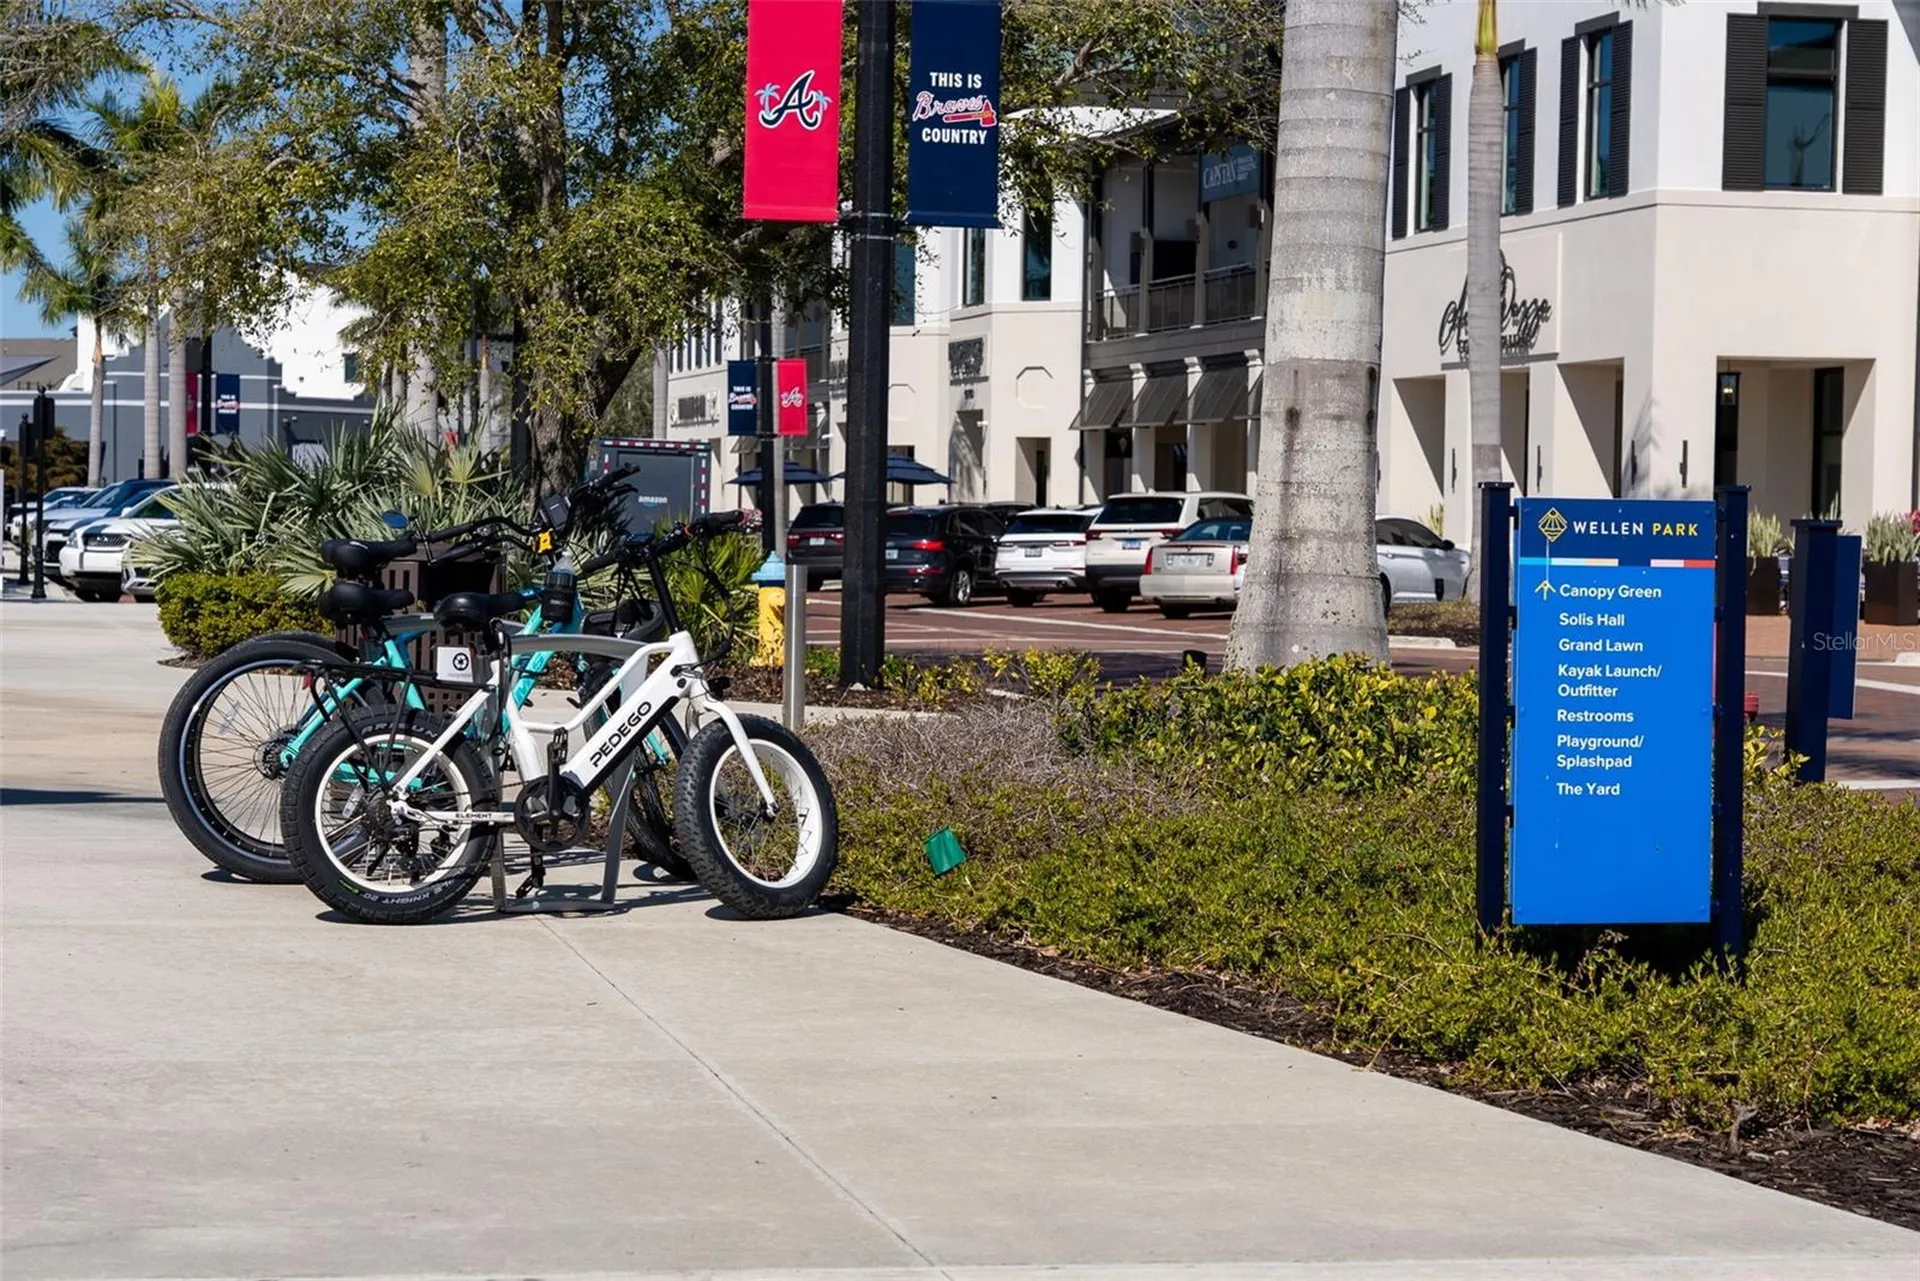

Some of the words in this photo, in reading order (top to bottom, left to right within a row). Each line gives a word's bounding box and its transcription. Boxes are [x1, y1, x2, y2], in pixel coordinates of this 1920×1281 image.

[929, 71, 963, 88] THIS
[967, 73, 983, 89] IS
[759, 69, 822, 131] A
[912, 90, 983, 122] Braves
[921, 127, 988, 145] COUNTRY
[638, 495, 668, 504] amazon
[1573, 521, 1643, 535] WELLEN
[1652, 523, 1698, 536] PARK
[1559, 584, 1615, 600] Canopy
[1618, 585, 1661, 598] Green
[1559, 613, 1593, 626] Solis
[1597, 613, 1625, 626] Hall
[1559, 638, 1602, 652] Grand
[1605, 639, 1643, 652] Lawn
[1558, 664, 1602, 680] Kayak
[1605, 664, 1662, 678] Launch/
[1557, 684, 1618, 697] Outfitter
[1557, 709, 1634, 723] Restrooms
[590, 701, 652, 768] PEDEGO
[1557, 735, 1644, 750] Playground/
[1557, 755, 1632, 770] Splashpad
[1557, 783, 1582, 795] The
[1586, 783, 1620, 796] Yard
[382, 892, 430, 904] KNIGHT
